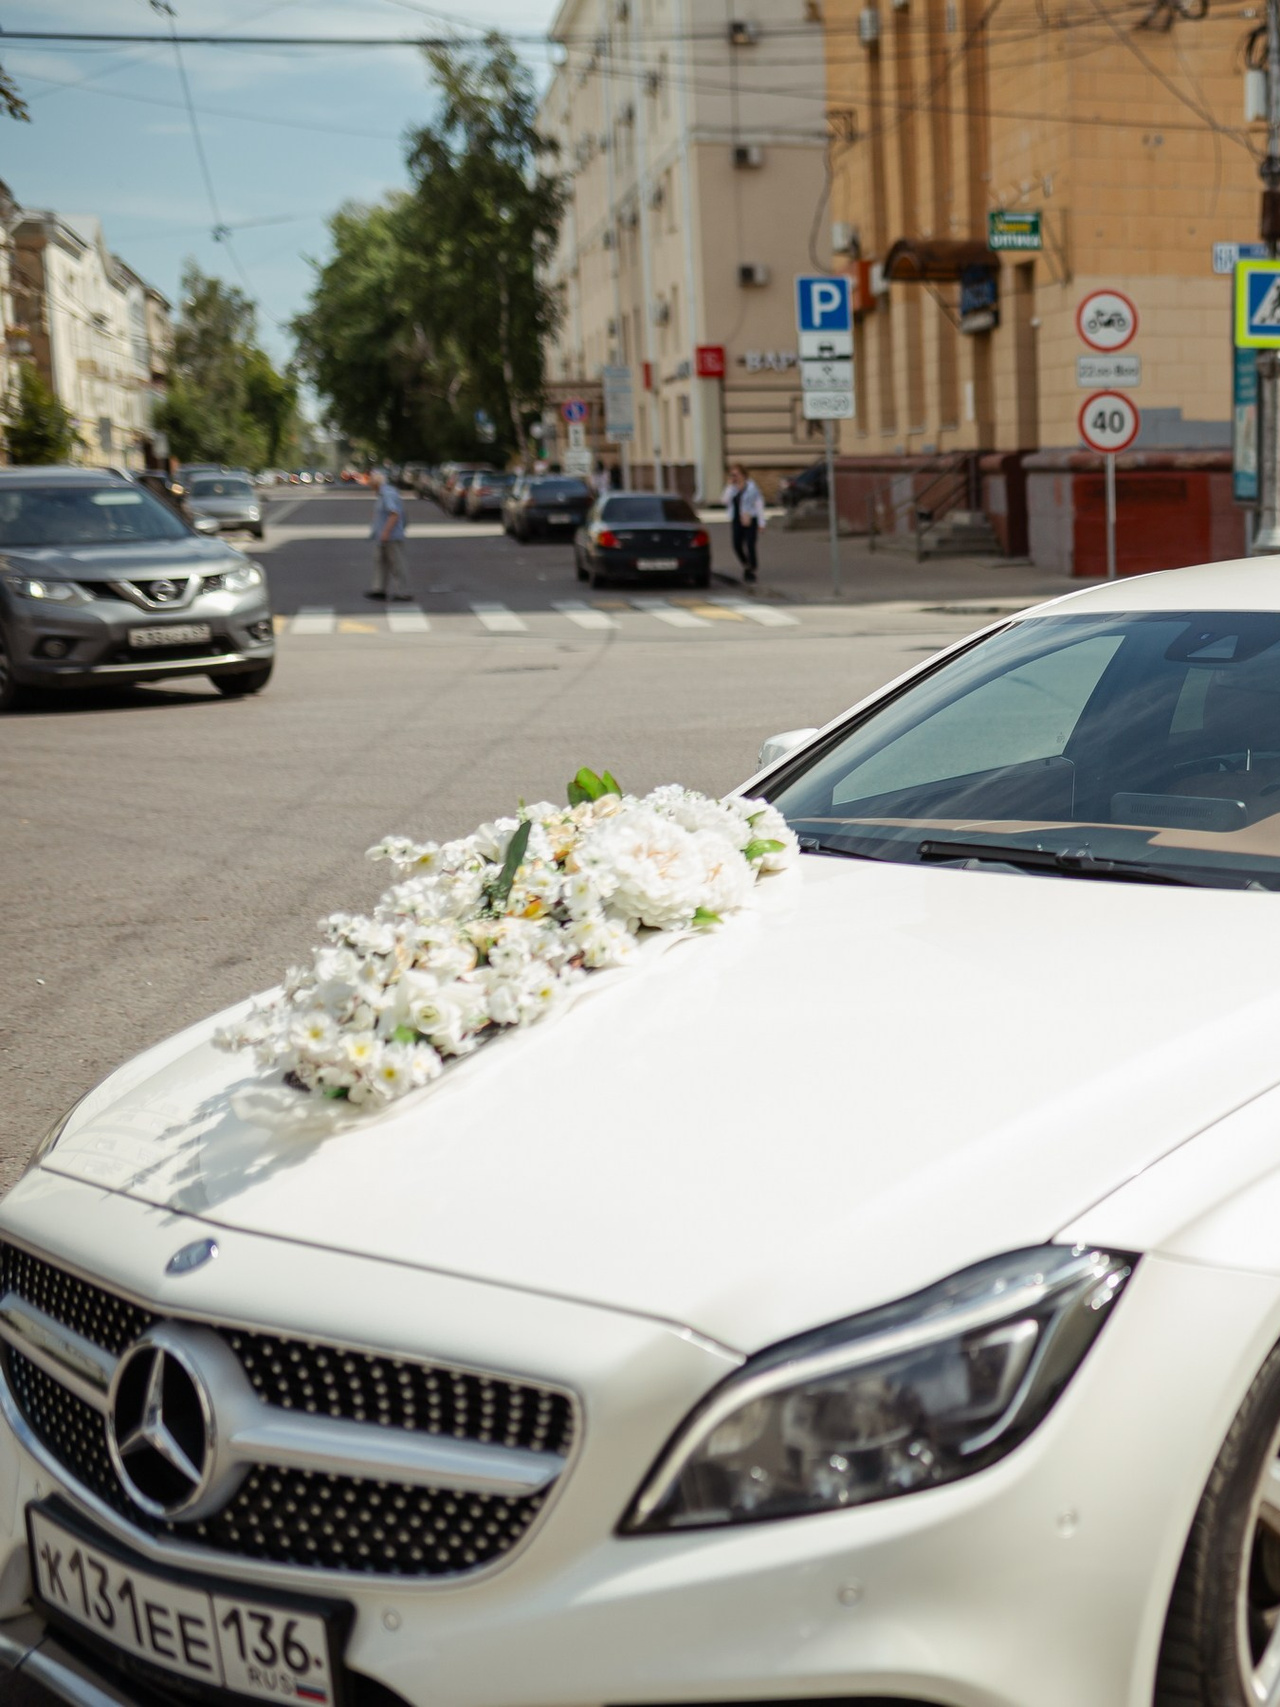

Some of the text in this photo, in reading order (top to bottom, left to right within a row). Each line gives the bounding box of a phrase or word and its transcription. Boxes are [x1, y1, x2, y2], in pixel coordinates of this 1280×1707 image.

[810, 281, 842, 328] P
[1092, 410, 1125, 433] 40
[222, 1607, 310, 1676] 136
[248, 1664, 295, 1696] RUS
